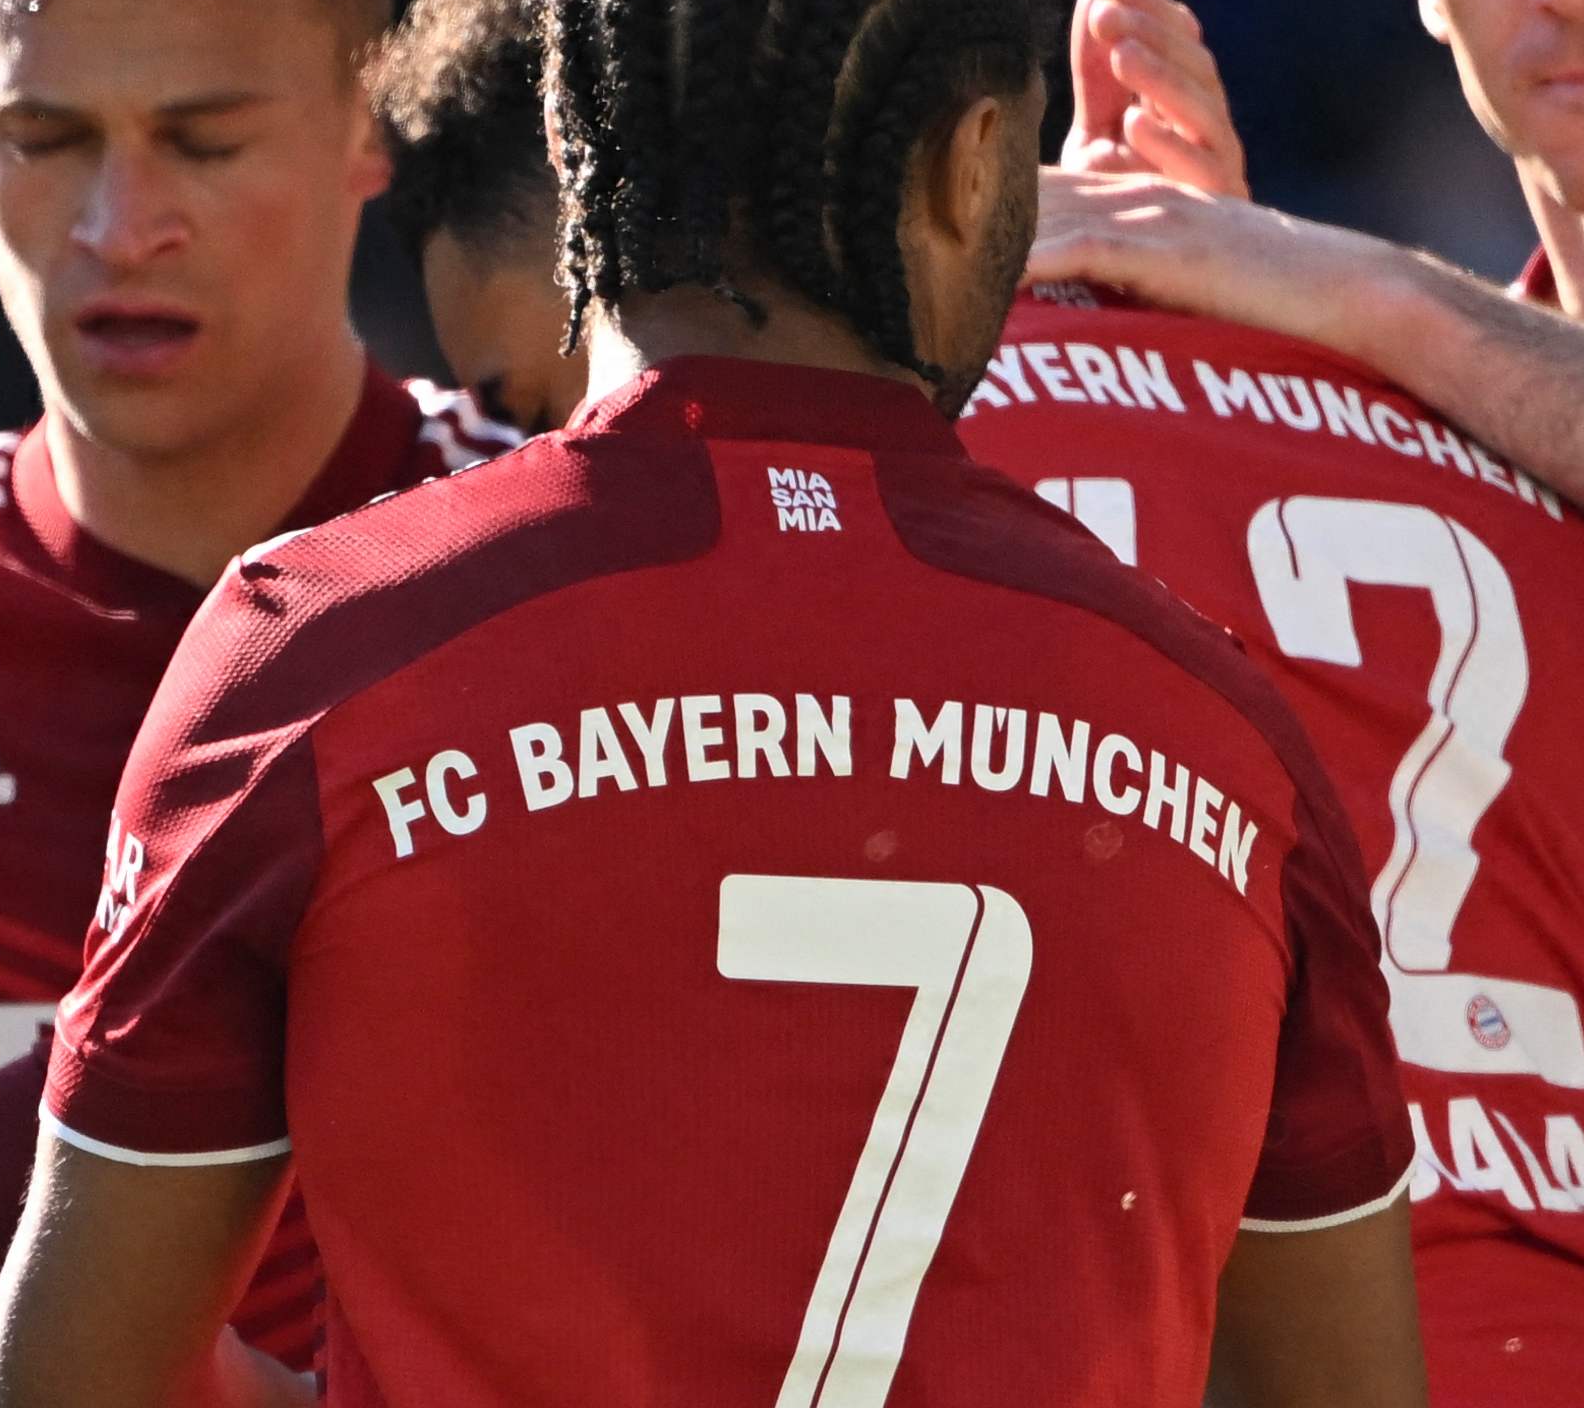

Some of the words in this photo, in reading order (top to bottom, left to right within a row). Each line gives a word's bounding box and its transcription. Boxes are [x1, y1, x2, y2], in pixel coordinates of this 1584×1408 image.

[959, 342, 1188, 419] AYERN
[767, 466, 832, 491] MIA
[770, 488, 837, 509] SAN
[777, 506, 842, 532] MIA
[372, 748, 488, 859] FC
[508, 693, 853, 813] BAYERN
[887, 698, 1259, 897] MÜNCHEN
